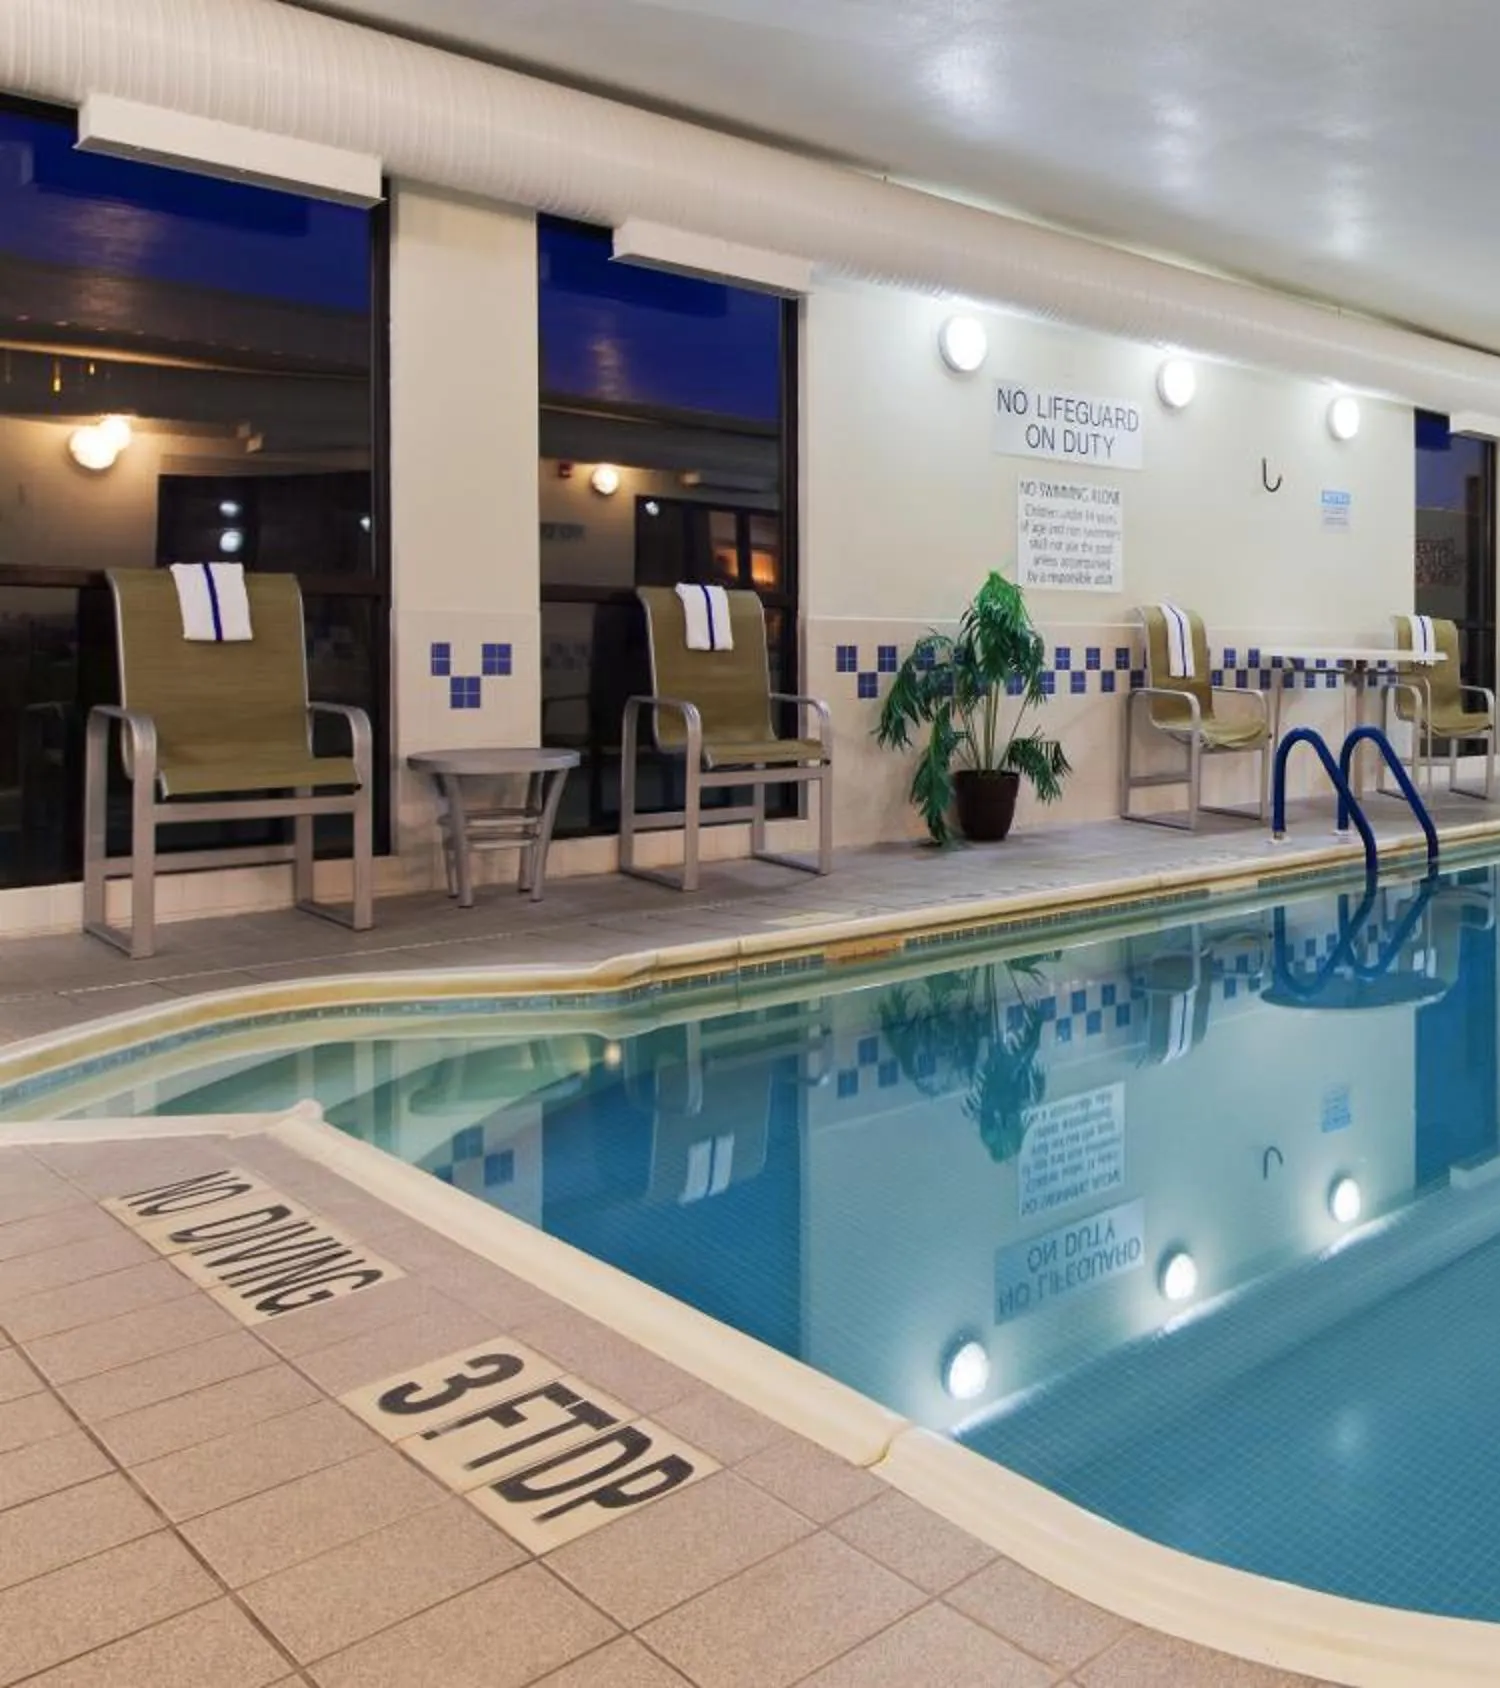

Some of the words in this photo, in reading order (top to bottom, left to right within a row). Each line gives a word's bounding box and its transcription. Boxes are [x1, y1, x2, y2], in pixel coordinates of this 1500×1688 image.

[997, 387, 1028, 415] NO
[1037, 393, 1139, 433] LIFEGUARD
[1025, 423, 1055, 451] ON
[1063, 429, 1115, 459] DUTY
[119, 1169, 254, 1218] NO
[167, 1203, 385, 1318] DIVING
[377, 1351, 525, 1416] 3
